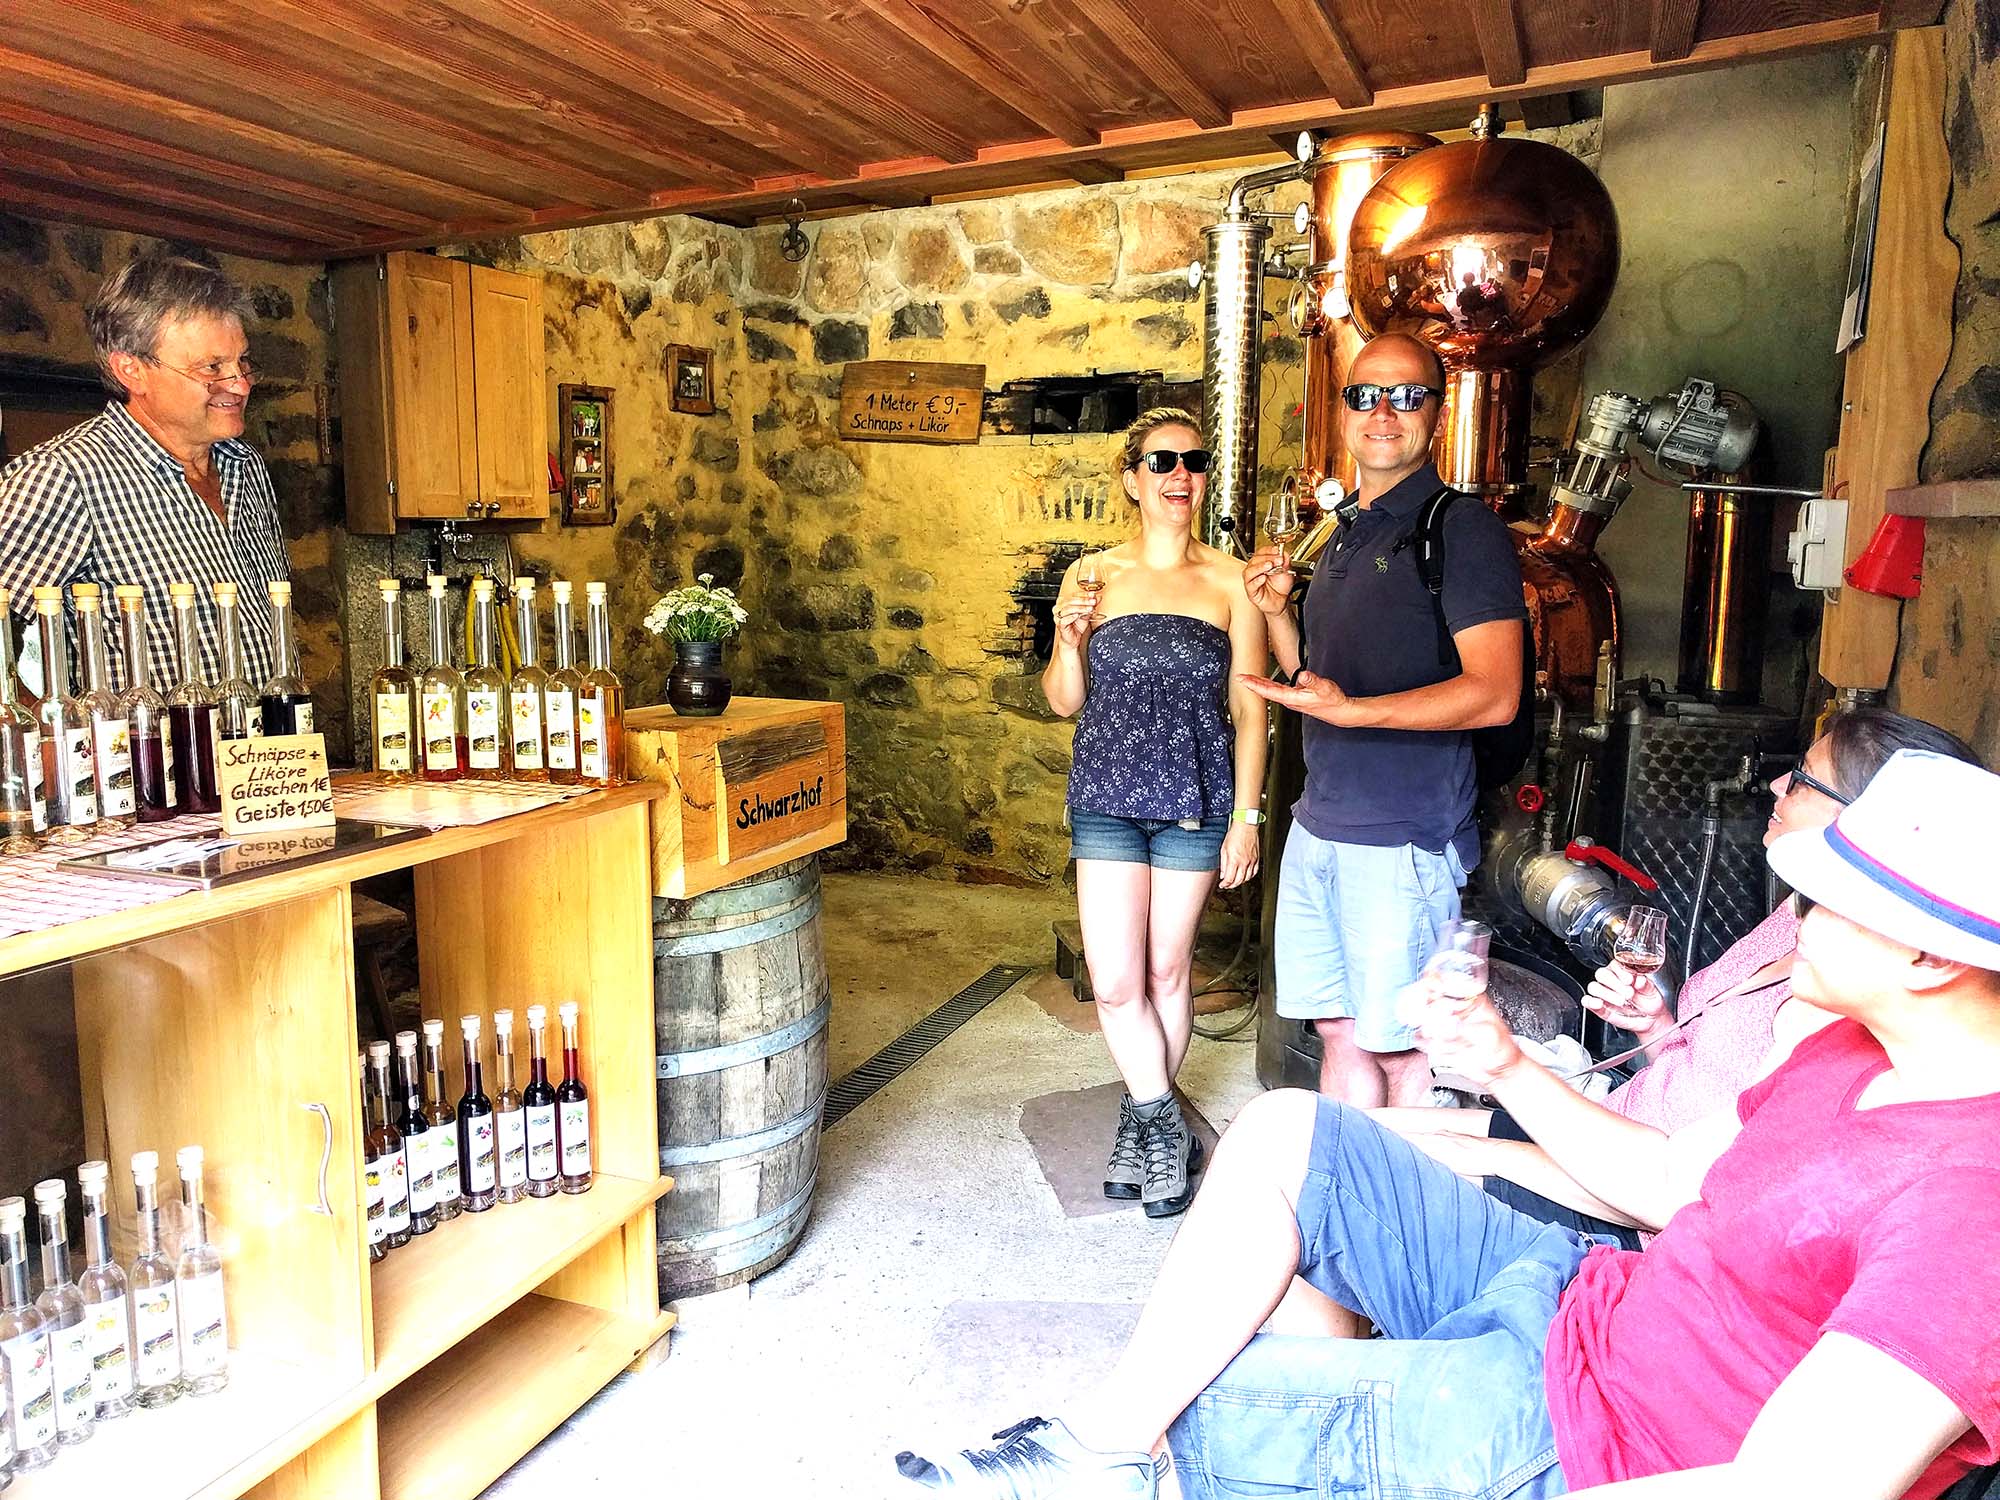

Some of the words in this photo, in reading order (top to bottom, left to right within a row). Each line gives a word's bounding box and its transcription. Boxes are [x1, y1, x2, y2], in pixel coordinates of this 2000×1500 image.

[866, 393, 875, 410] 1
[880, 393, 919, 411] Meter
[850, 413, 903, 433] Schnaps
[909, 422, 915, 430] +
[919, 416, 950, 433] Likör
[225, 744, 307, 767] Schnäpse
[309, 750, 320, 760] +
[247, 766, 308, 782] Liköre
[231, 780, 308, 801] Gläschen
[310, 776, 329, 793] 1€
[235, 799, 296, 824] Geiste
[736, 775, 824, 830] Schwarzhof
